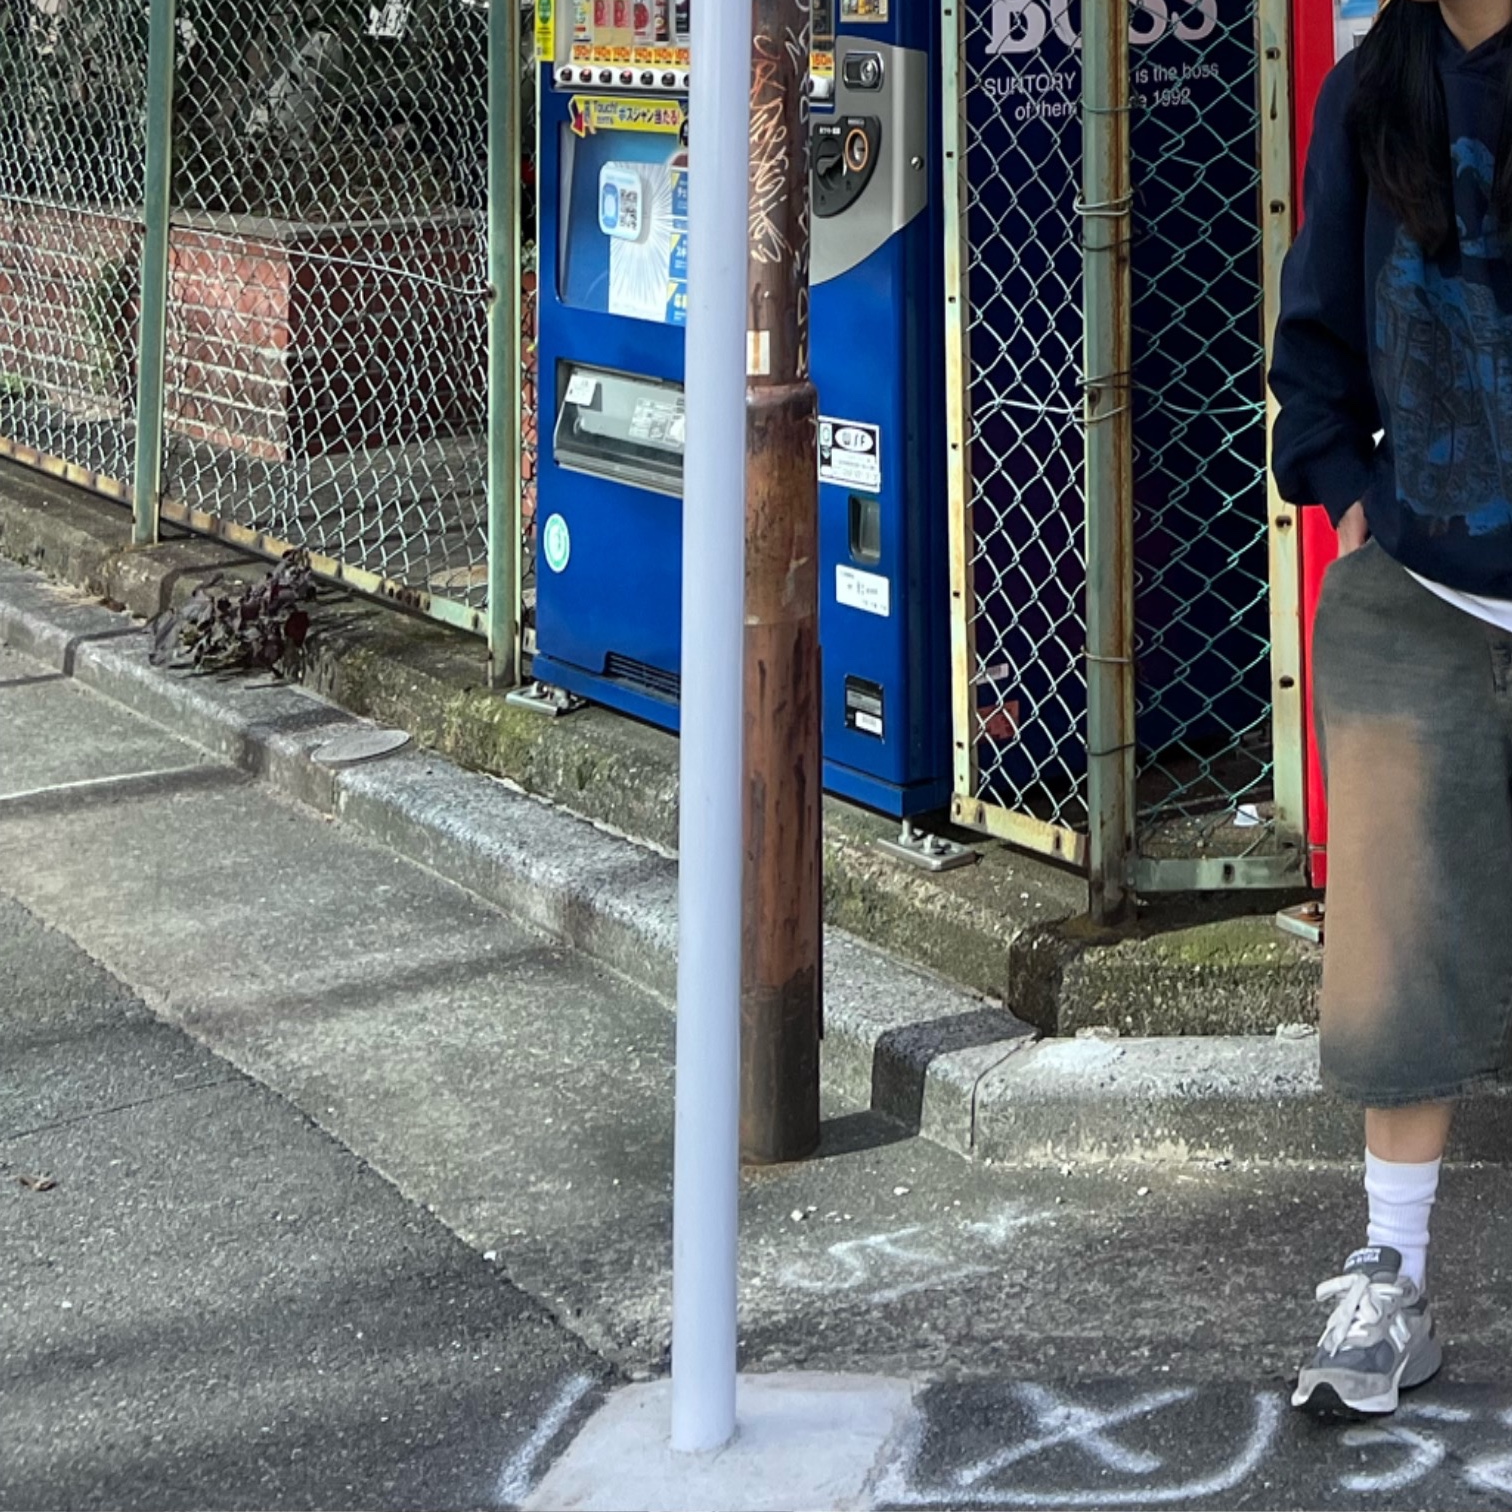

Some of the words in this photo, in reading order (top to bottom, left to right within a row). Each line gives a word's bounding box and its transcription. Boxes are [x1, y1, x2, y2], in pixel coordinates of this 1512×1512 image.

[984, 71, 1076, 97] SUNTORY
[1135, 68, 1148, 83] is
[1153, 65, 1177, 82] the
[1183, 62, 1219, 79] boss
[1015, 104, 1031, 121] of
[1153, 88, 1191, 106] 1992
